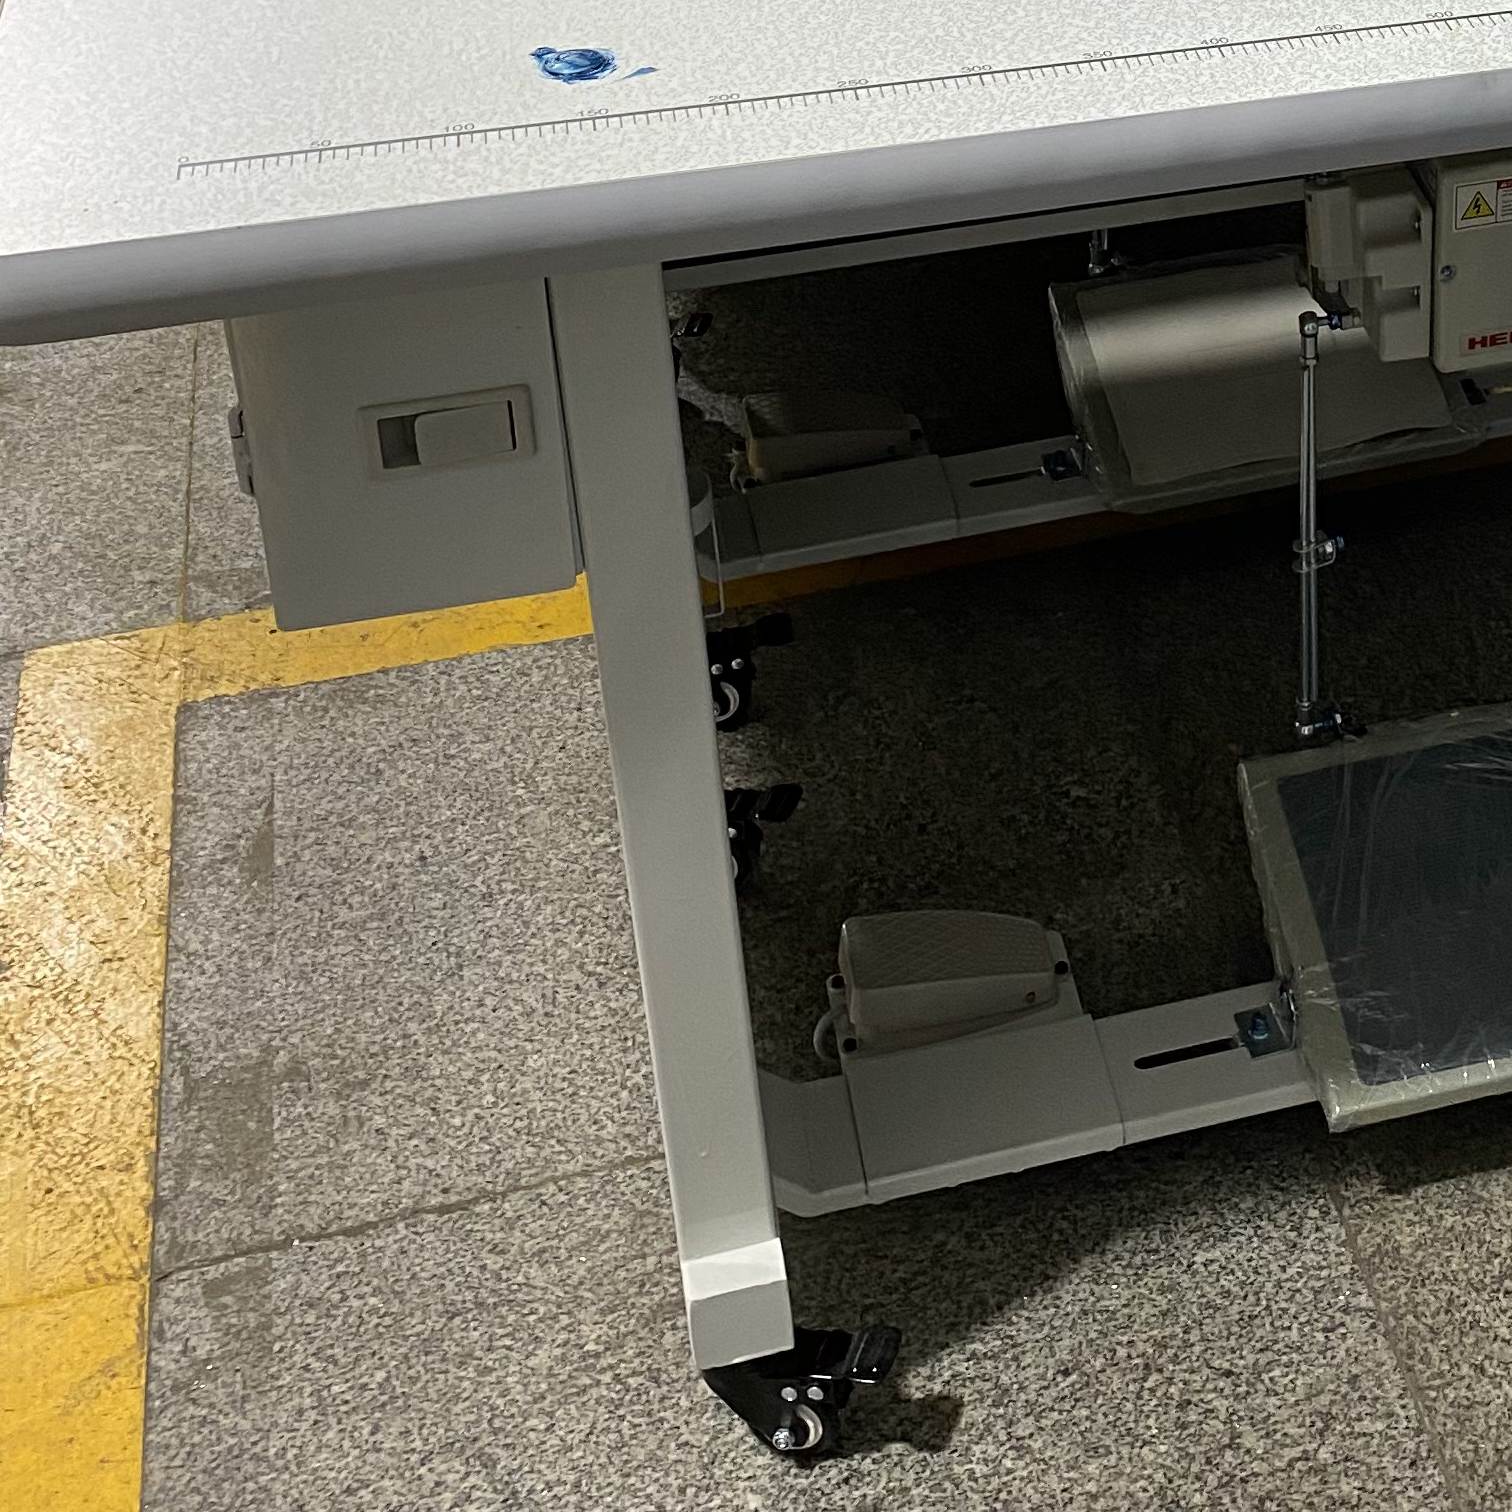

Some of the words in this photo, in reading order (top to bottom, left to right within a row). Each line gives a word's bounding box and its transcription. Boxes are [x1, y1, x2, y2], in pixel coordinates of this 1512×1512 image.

[444, 122, 476, 133] 100
[708, 92, 741, 102] 200
[961, 64, 993, 74] 300
[1200, 36, 1230, 46] 400
